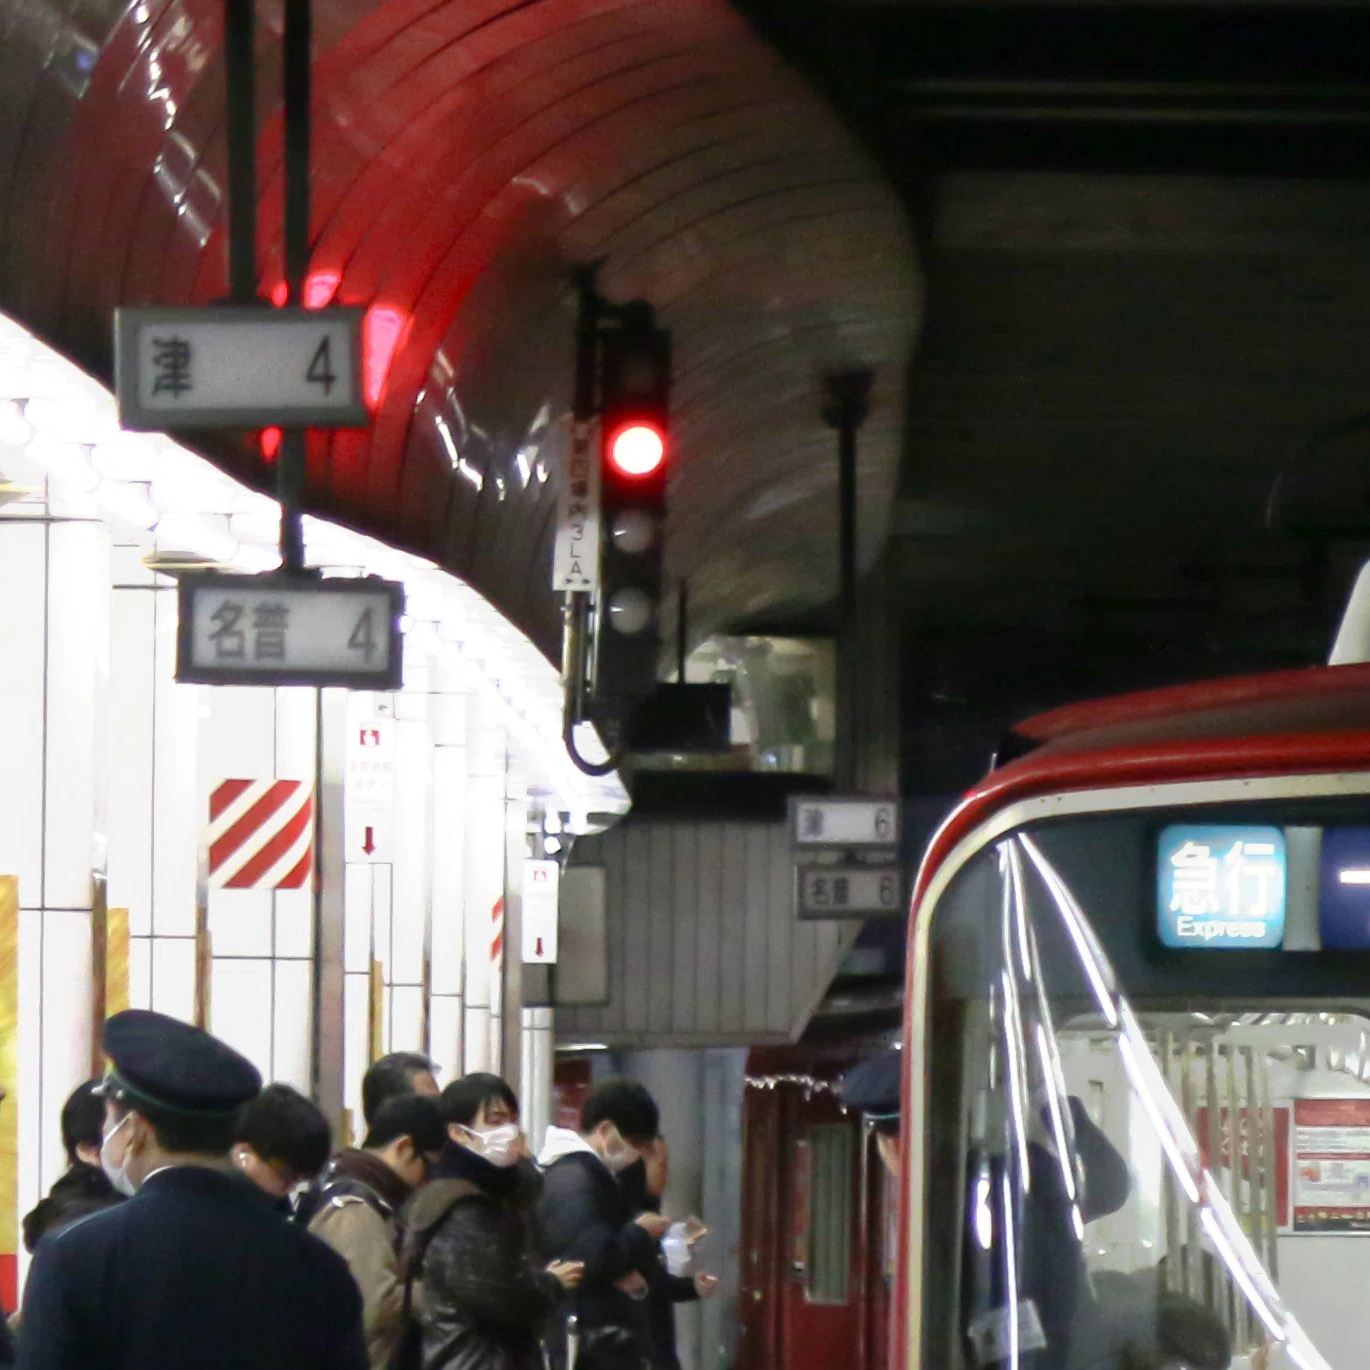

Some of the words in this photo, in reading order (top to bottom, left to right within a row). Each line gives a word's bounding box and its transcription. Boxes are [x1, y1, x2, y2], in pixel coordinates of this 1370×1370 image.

[152, 337, 193, 396] 津
[305, 336, 335, 393] 4
[207, 601, 289, 662] 名普
[347, 609, 378, 657] 4
[875, 807, 891, 838] 6
[880, 875, 895, 905] 6
[1169, 840, 1276, 915] 急行
[1176, 916, 1267, 940] Express
